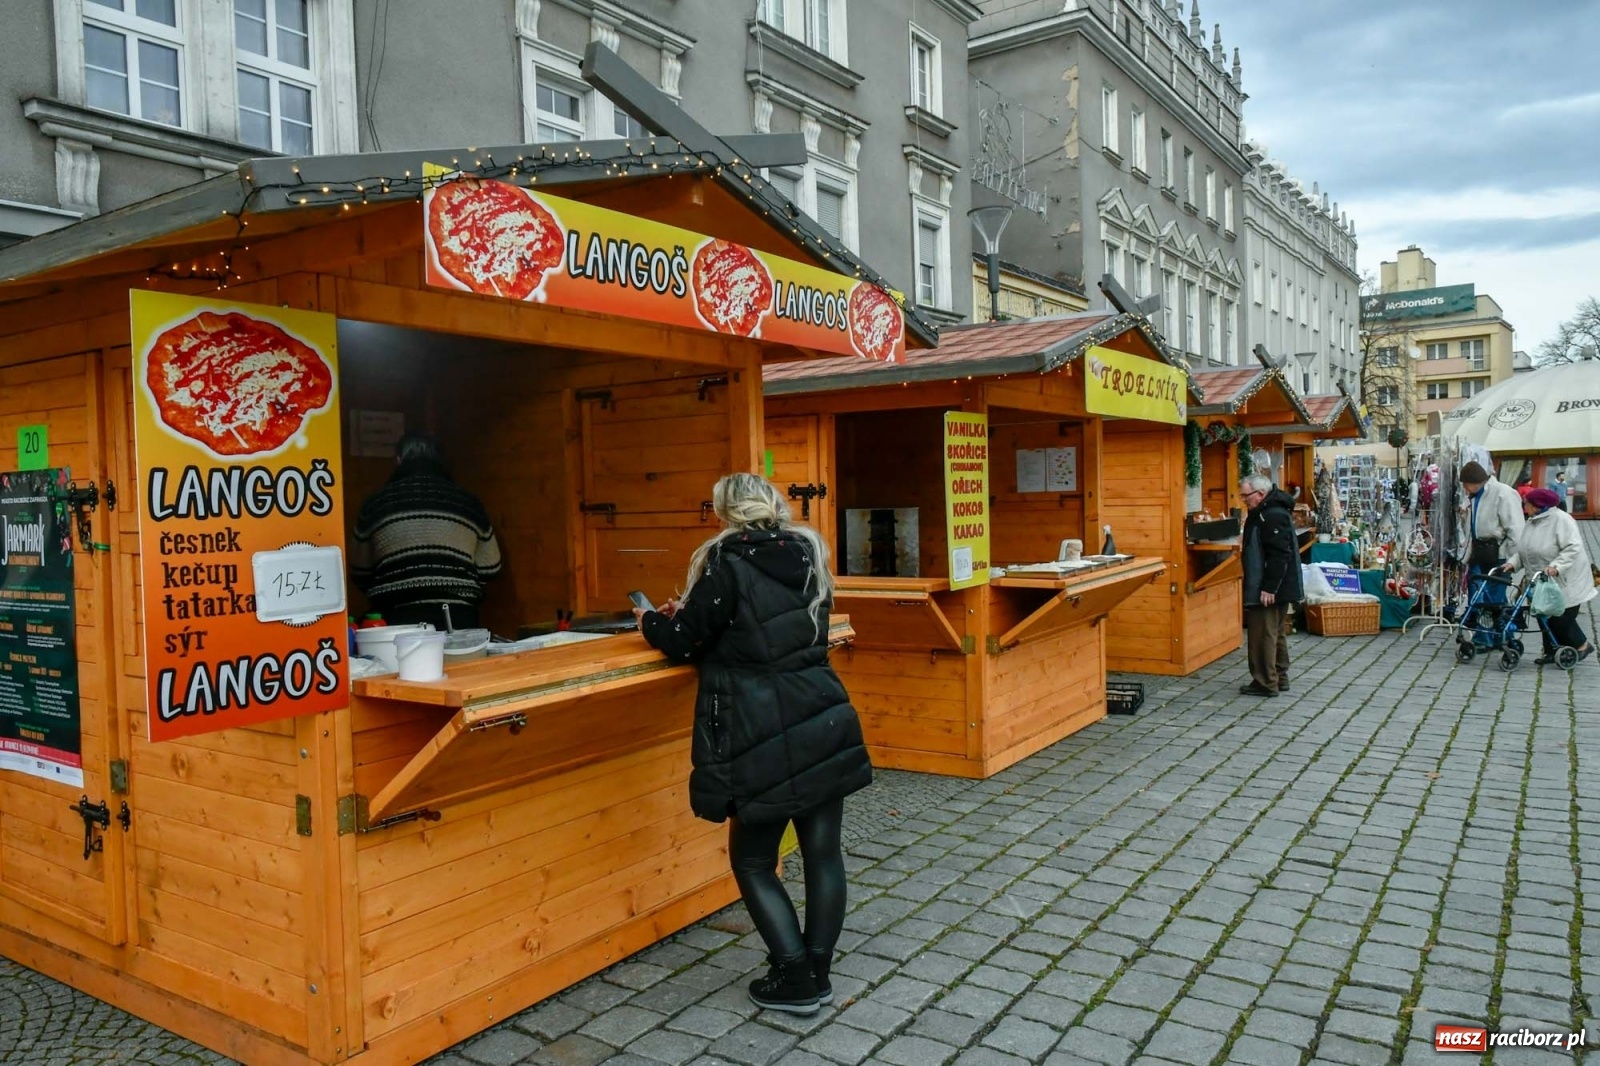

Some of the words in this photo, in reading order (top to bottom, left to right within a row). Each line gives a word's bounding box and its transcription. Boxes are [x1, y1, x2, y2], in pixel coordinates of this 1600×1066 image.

[567, 231, 688, 297] LANGOŠ
[774, 281, 848, 331] LANGOŠ
[1385, 296, 1444, 311] McDonald's
[1101, 365, 1179, 405] TRDELNÍK
[24, 431, 40, 454] 20
[947, 421, 986, 439] VANILKA
[947, 442, 987, 460] SKOŘICE
[149, 459, 334, 519] LANGOŠ
[952, 477, 983, 494] OŘECH
[953, 501, 983, 517] KOKOS
[160, 527, 242, 555] česnek
[953, 523, 984, 541] KAKAO
[162, 560, 238, 590] kečup
[164, 588, 257, 621] tatarka
[165, 626, 208, 657] sýr
[159, 640, 339, 721] LANGOŠ
